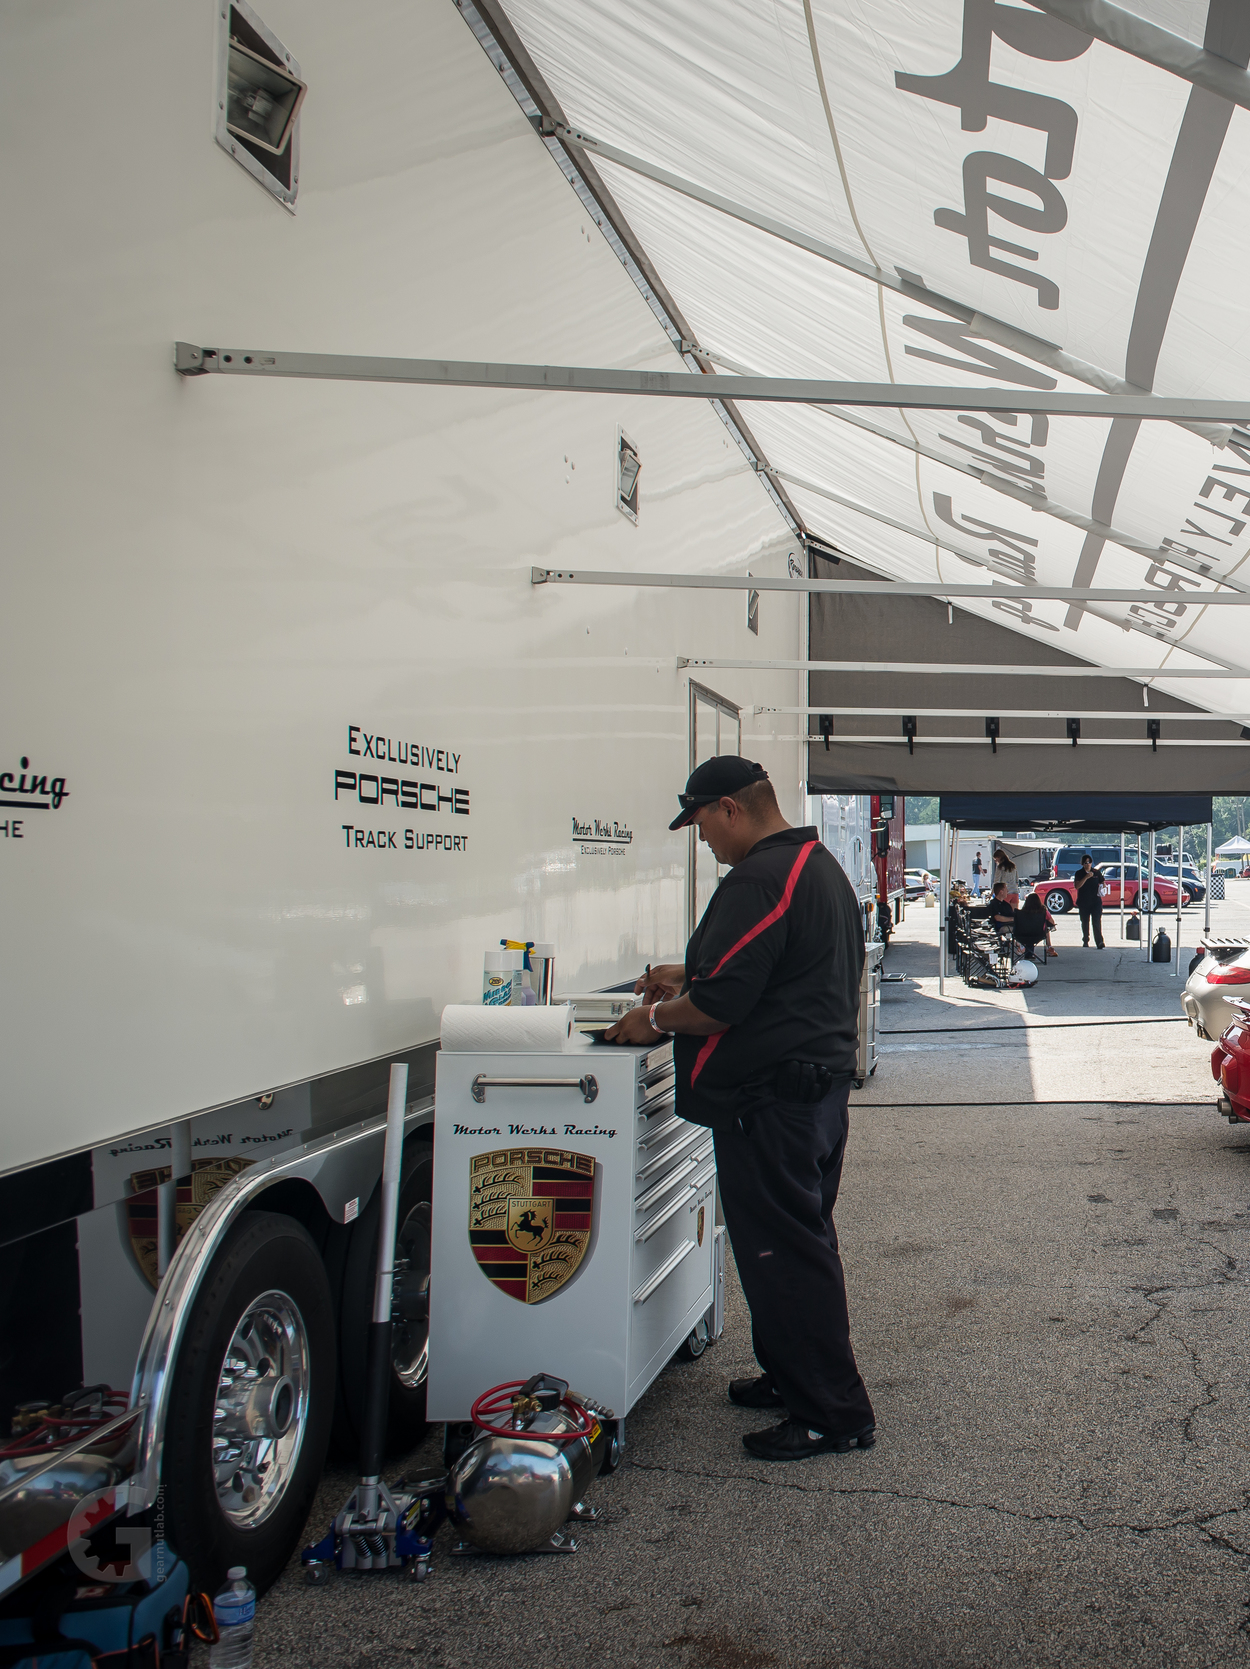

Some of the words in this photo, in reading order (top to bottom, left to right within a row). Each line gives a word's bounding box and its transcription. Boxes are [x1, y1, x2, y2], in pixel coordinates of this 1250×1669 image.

[334, 769, 470, 815] PORSCHE
[342, 825, 397, 849] TRACK
[404, 829, 468, 851] SUPPORT
[572, 817, 593, 836] Motor
[594, 819, 612, 837] Werks
[613, 821, 633, 844] Racing
[453, 1124, 502, 1136] Motor
[507, 1124, 558, 1136] Werks
[563, 1124, 618, 1139] Racing
[472, 1150, 594, 1175] PORSCHE
[511, 1200, 551, 1208] STUTTGART
